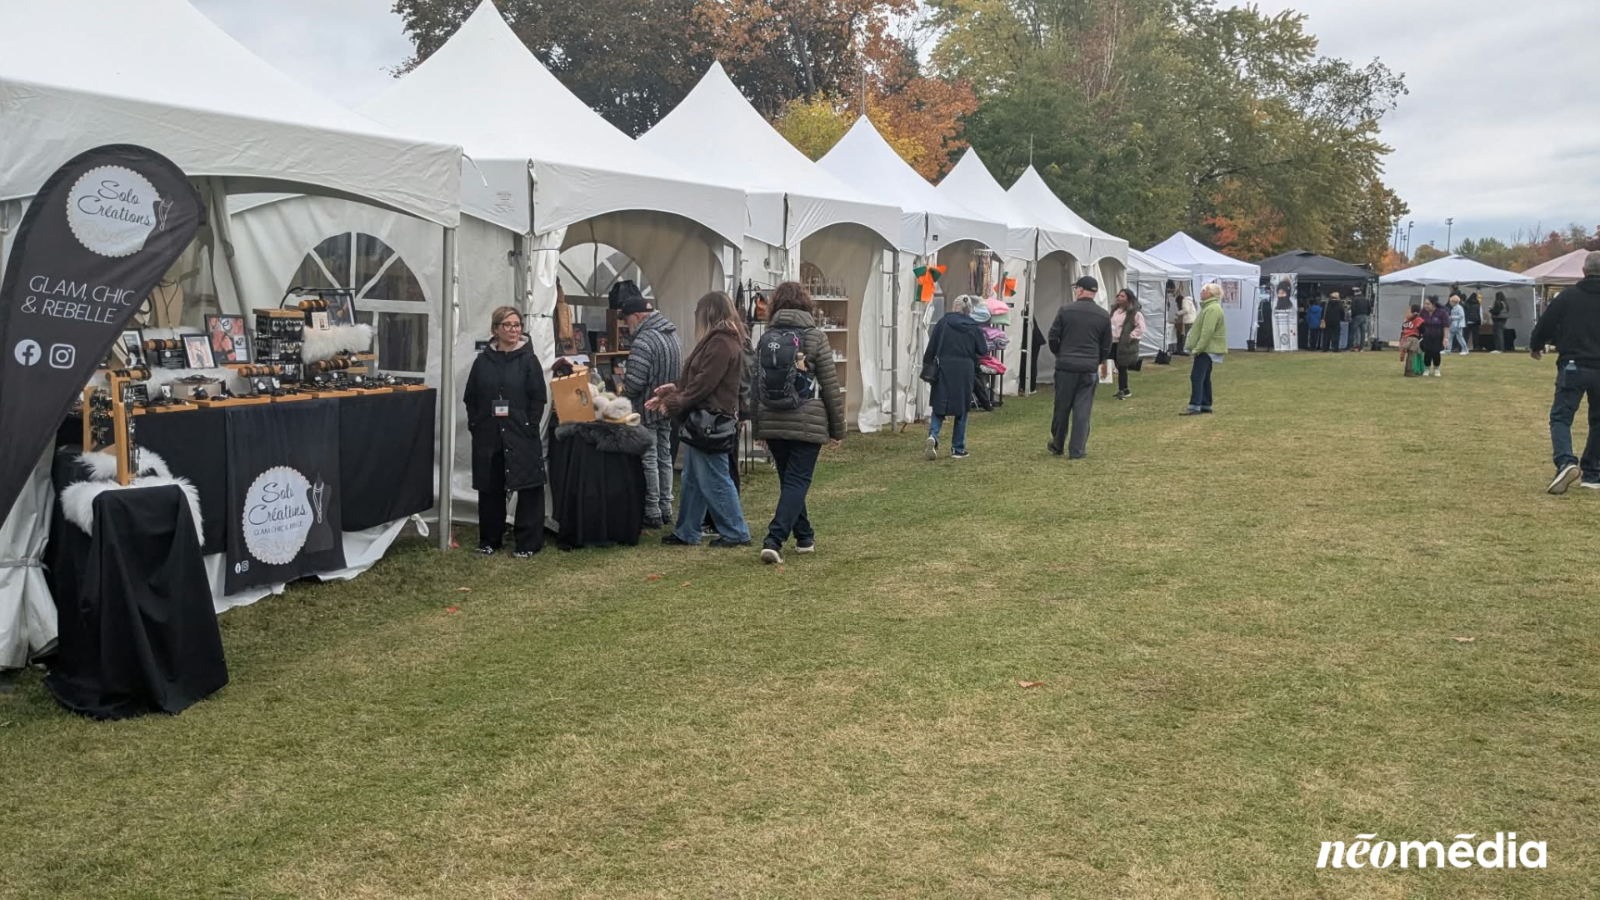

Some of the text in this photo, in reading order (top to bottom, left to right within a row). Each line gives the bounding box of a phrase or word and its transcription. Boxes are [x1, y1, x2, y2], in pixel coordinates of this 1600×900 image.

[98, 180, 140, 204] Solo
[77, 195, 152, 226] Créations
[29, 275, 135, 306] GLAM, CHIC
[20, 295, 117, 324] & REBELLE
